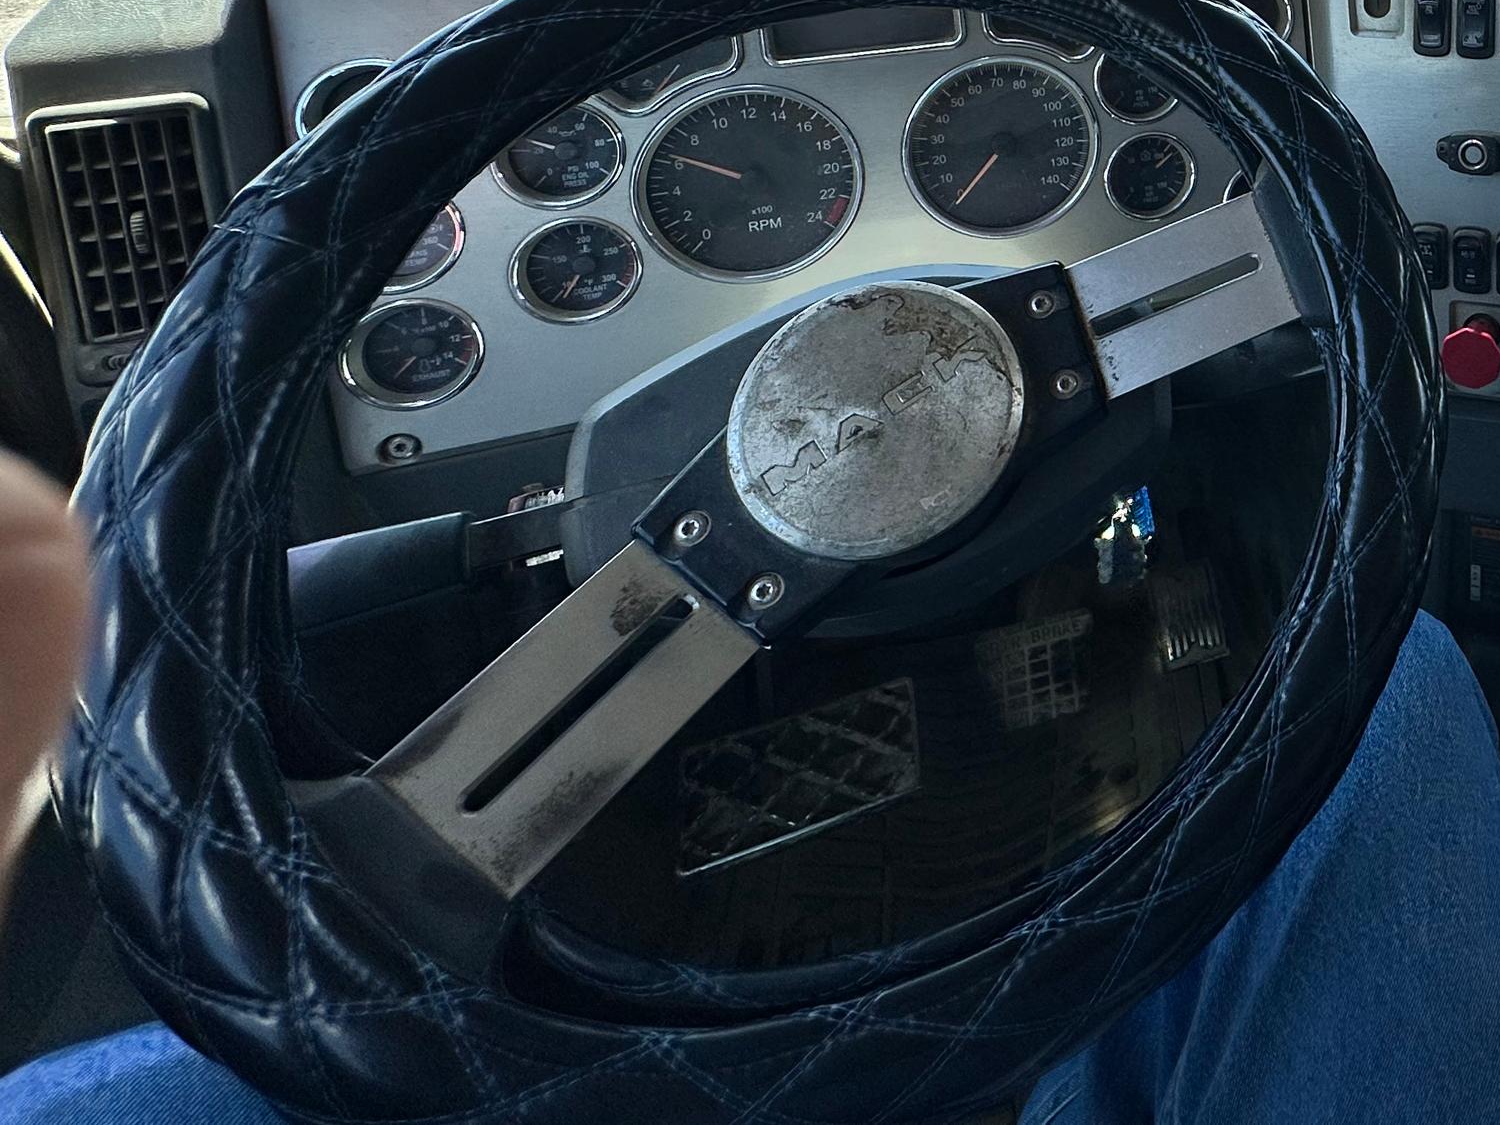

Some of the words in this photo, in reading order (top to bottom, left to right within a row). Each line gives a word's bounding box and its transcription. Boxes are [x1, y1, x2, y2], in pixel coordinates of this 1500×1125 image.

[990, 77, 1004, 88] 70
[1012, 79, 1027, 90] 80
[967, 85, 982, 95] 60
[1031, 87, 1046, 98] 90
[951, 97, 965, 108] 50
[1043, 101, 1062, 112] 100
[740, 107, 757, 120] 12
[770, 110, 787, 123] 14
[935, 113, 950, 124] 40
[712, 116, 728, 129] 10
[796, 120, 813, 133] 16
[1052, 117, 1071, 128] 110
[690, 134, 700, 146] 8
[815, 139, 832, 151] 18
[930, 134, 945, 145] 30
[1055, 136, 1074, 147] 120
[584, 160, 600, 170] 100
[674, 159, 684, 170] 6
[932, 154, 947, 165] 20
[1050, 156, 1069, 167] 130
[823, 162, 840, 175] 20
[940, 173, 953, 184] 10
[1041, 175, 1060, 186] 140
[672, 185, 681, 197] 4
[819, 187, 836, 200] 22
[751, 204, 773, 216] x100
[683, 210, 693, 222] 2
[806, 210, 823, 223] 24
[748, 216, 783, 233] RPM
[575, 235, 592, 244] 200
[702, 229, 712, 241] 0
[603, 246, 619, 256] 250
[601, 273, 617, 283] 300
[572, 284, 608, 295] COOLANT
